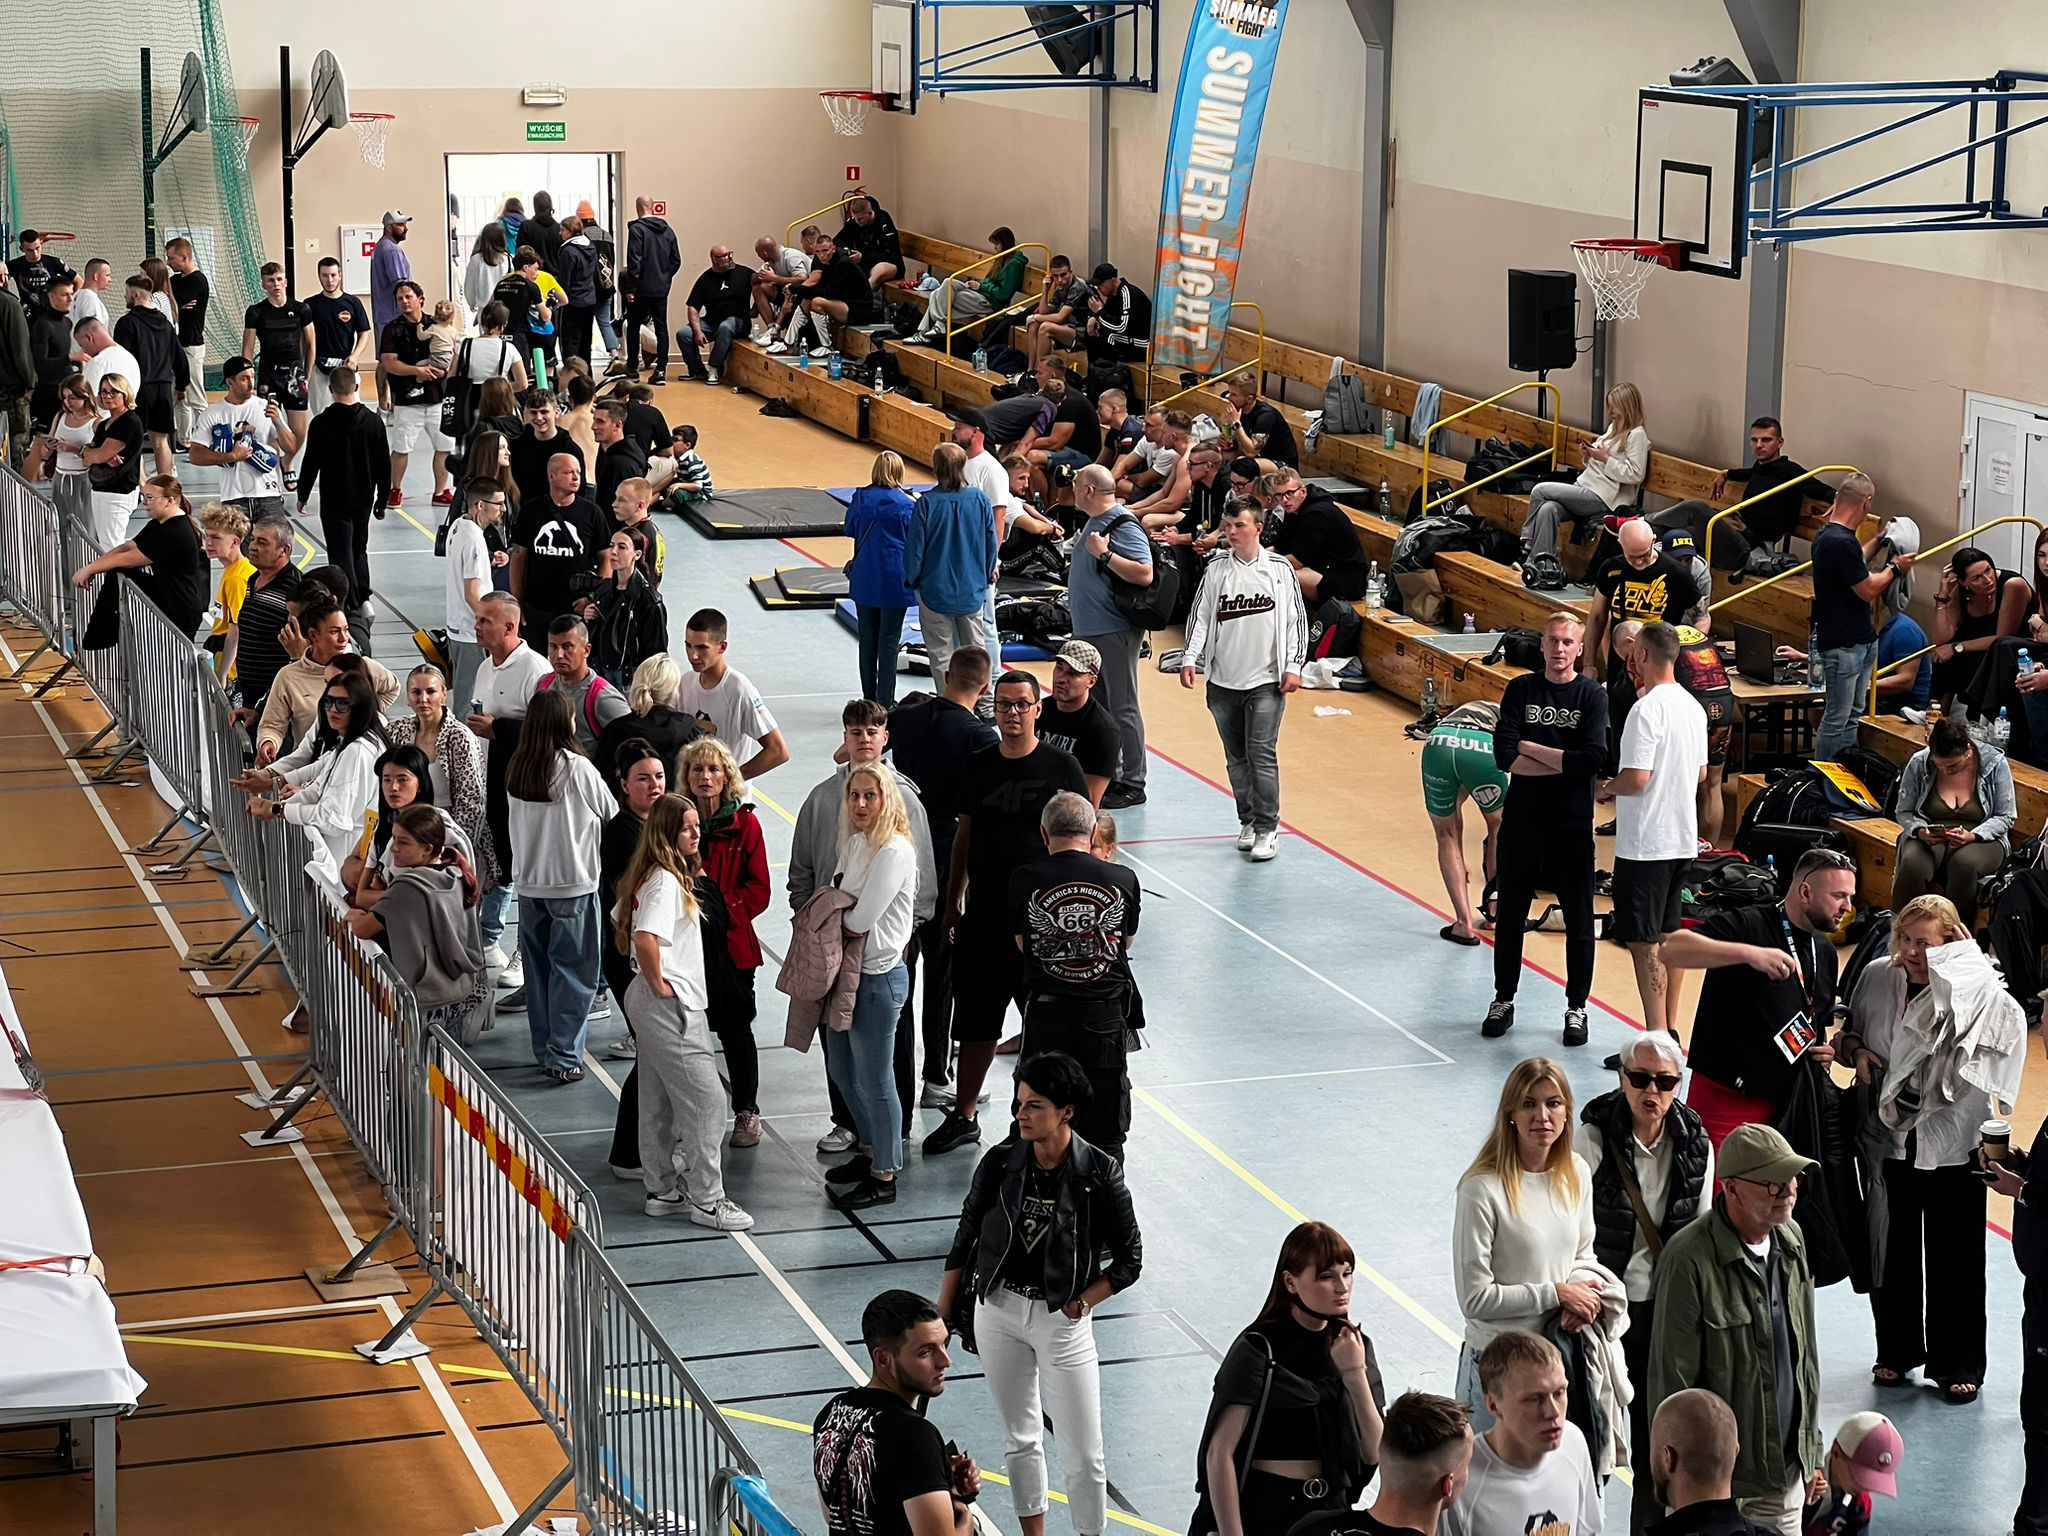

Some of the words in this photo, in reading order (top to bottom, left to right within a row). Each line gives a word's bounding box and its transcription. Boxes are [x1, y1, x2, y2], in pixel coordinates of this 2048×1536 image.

[1236, 20, 1265, 38] FIGHT
[529, 124, 563, 132] WYJŚCIE
[1179, 46, 1254, 222] SUMMER
[1171, 232, 1221, 350] FIGHT
[1219, 593, 1273, 611] Infinite
[1525, 704, 1582, 729] BOSS
[981, 780, 1047, 812] 4F
[1042, 886, 1078, 909] AMERICA'S
[1080, 887, 1111, 905] HIGHWAY
[1063, 913, 1094, 931] 66
[1049, 964, 1063, 975] THE
[1022, 1200, 1054, 1216] UESS
